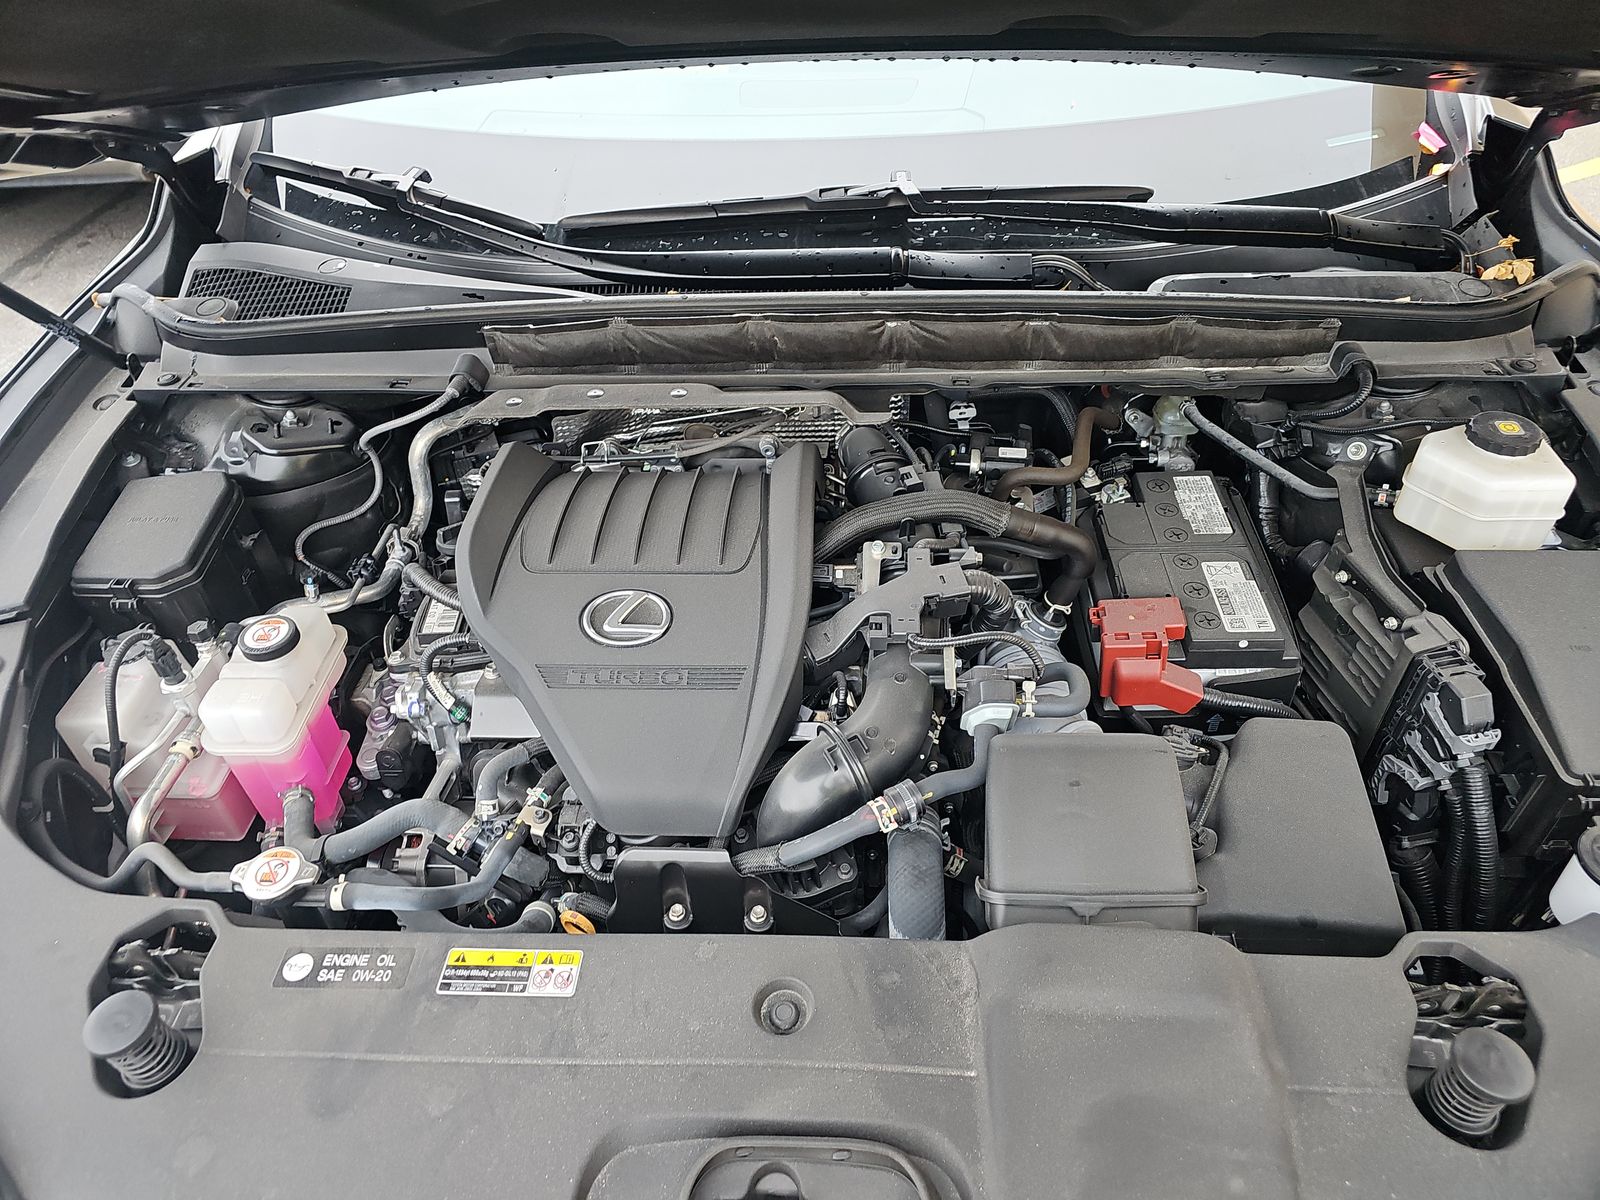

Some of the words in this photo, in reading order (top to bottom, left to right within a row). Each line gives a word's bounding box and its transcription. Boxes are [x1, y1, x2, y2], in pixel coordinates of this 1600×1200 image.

[569, 669, 685, 685] TURBO
[322, 954, 370, 967] ENGINE
[376, 954, 397, 967] OIL
[317, 968, 345, 982] SAE
[351, 969, 392, 982] 0W-20
